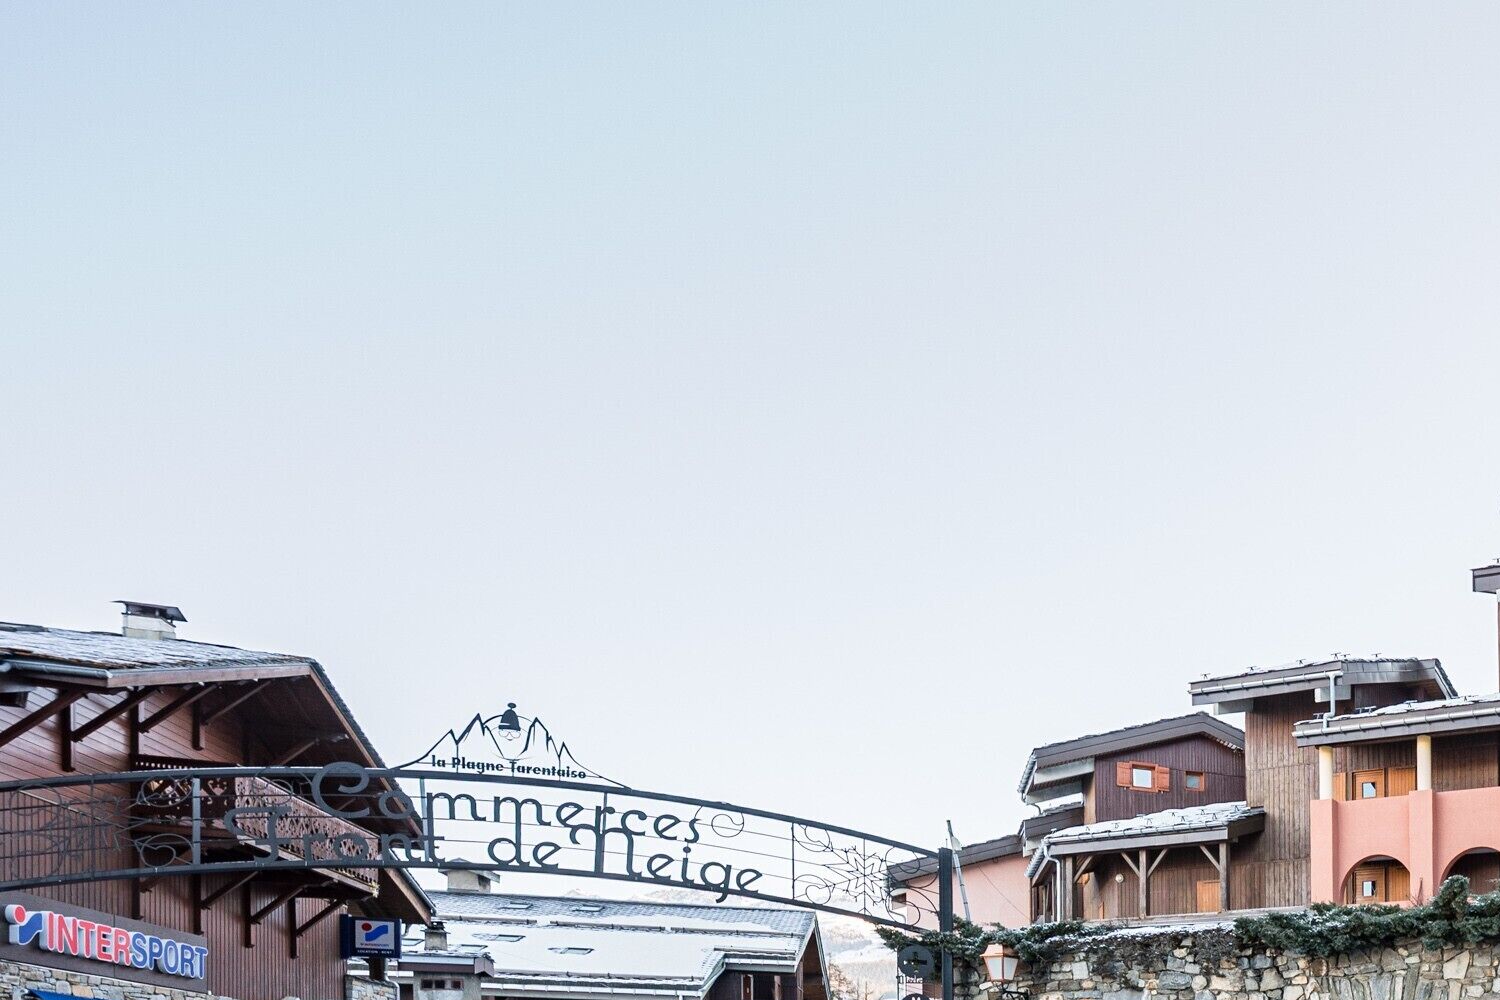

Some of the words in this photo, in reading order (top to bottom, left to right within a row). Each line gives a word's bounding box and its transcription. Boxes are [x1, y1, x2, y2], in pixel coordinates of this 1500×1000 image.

[312, 762, 700, 844] Commerces
[432, 754, 446, 767] la
[451, 757, 504, 774] Plagne
[509, 760, 587, 779] Tarentaise
[488, 818, 561, 867] de
[570, 823, 764, 904] Neige
[45, 911, 209, 980] INTERSPORT
